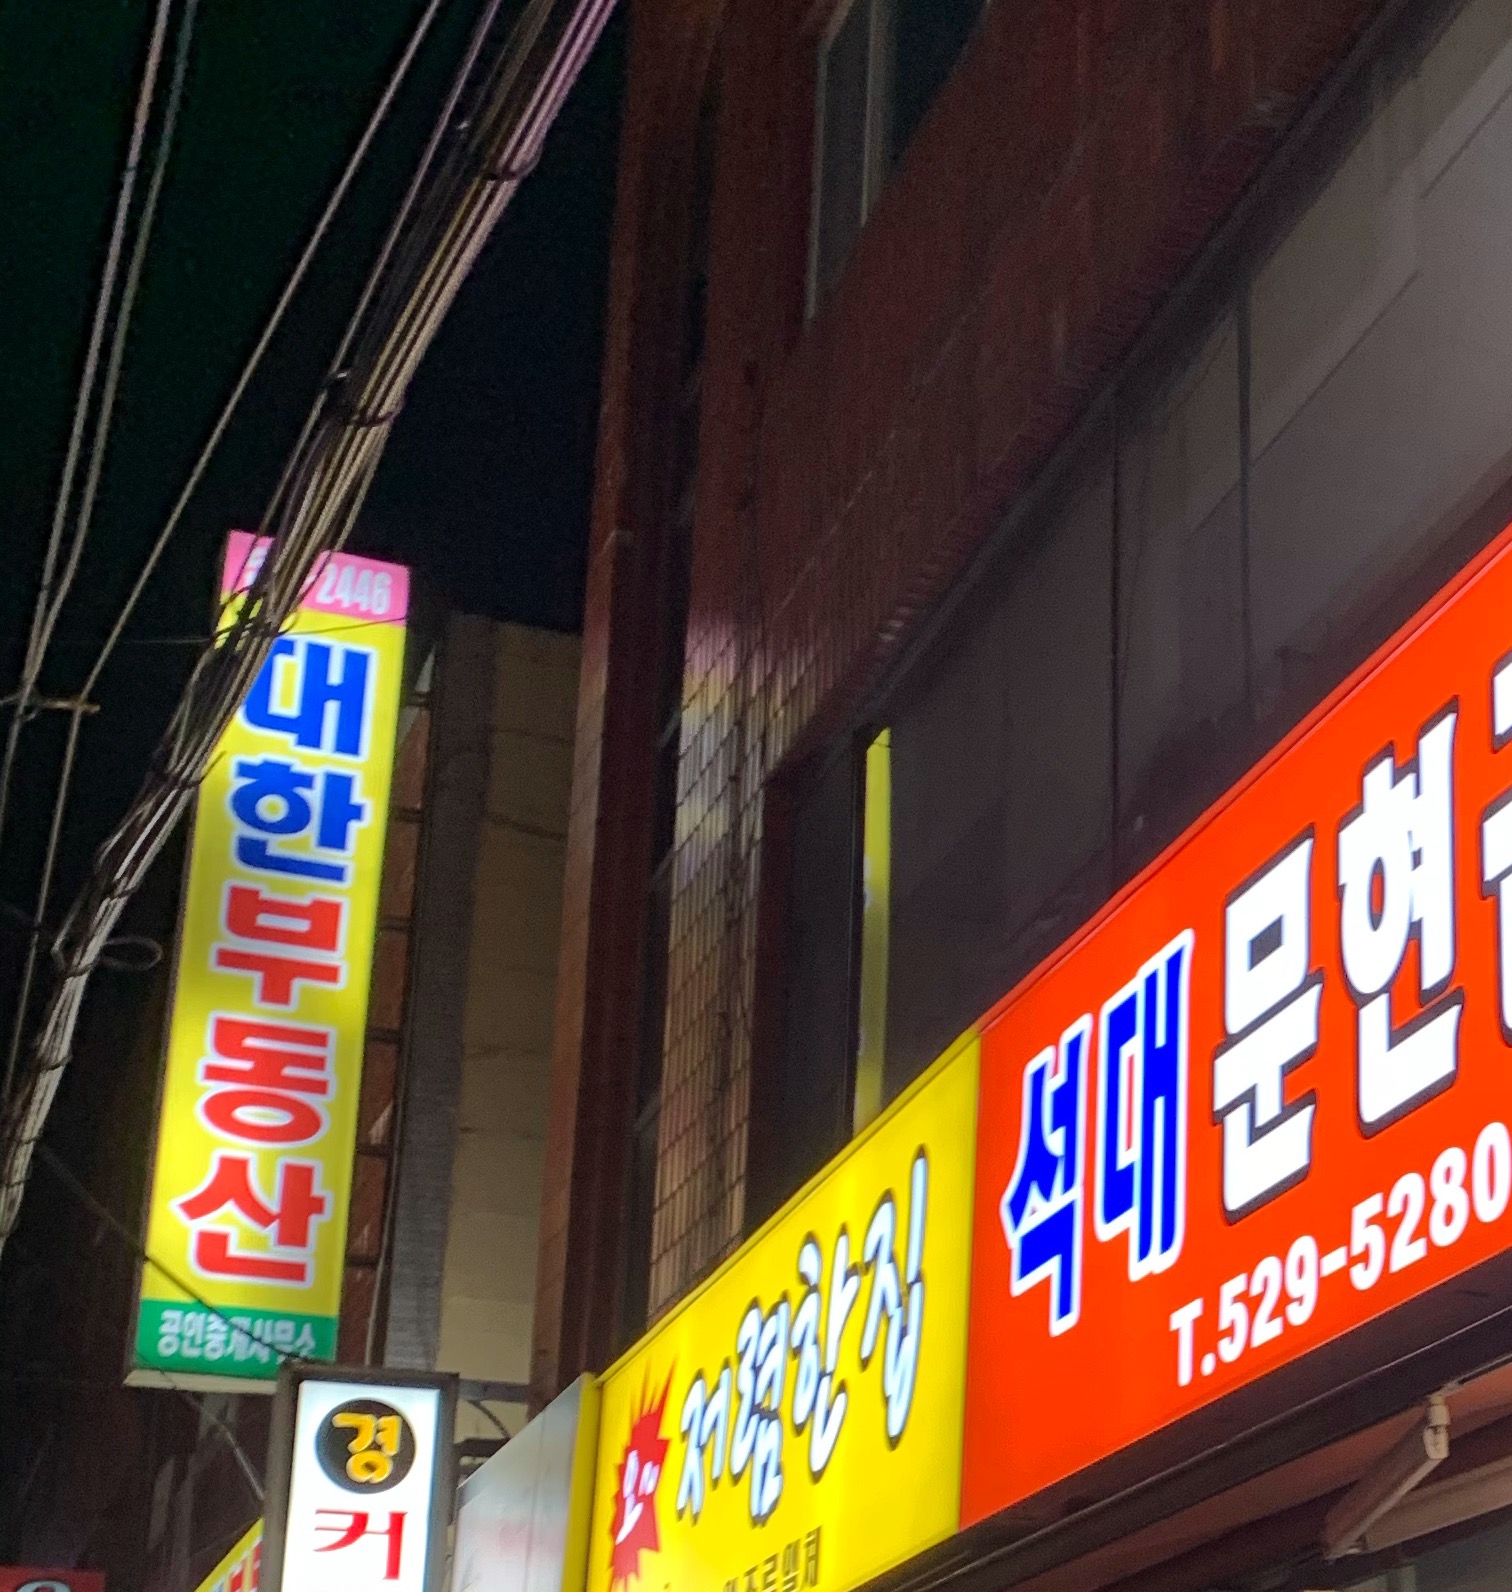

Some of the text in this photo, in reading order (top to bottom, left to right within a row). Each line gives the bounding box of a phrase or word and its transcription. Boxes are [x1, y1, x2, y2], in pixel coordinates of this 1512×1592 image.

[178, 638, 375, 1286] 대한부동산
[1001, 928, 1195, 1337] 석대
[1169, 1120, 1512, 1388] T.529-5280
[332, 1410, 401, 1484] 경
